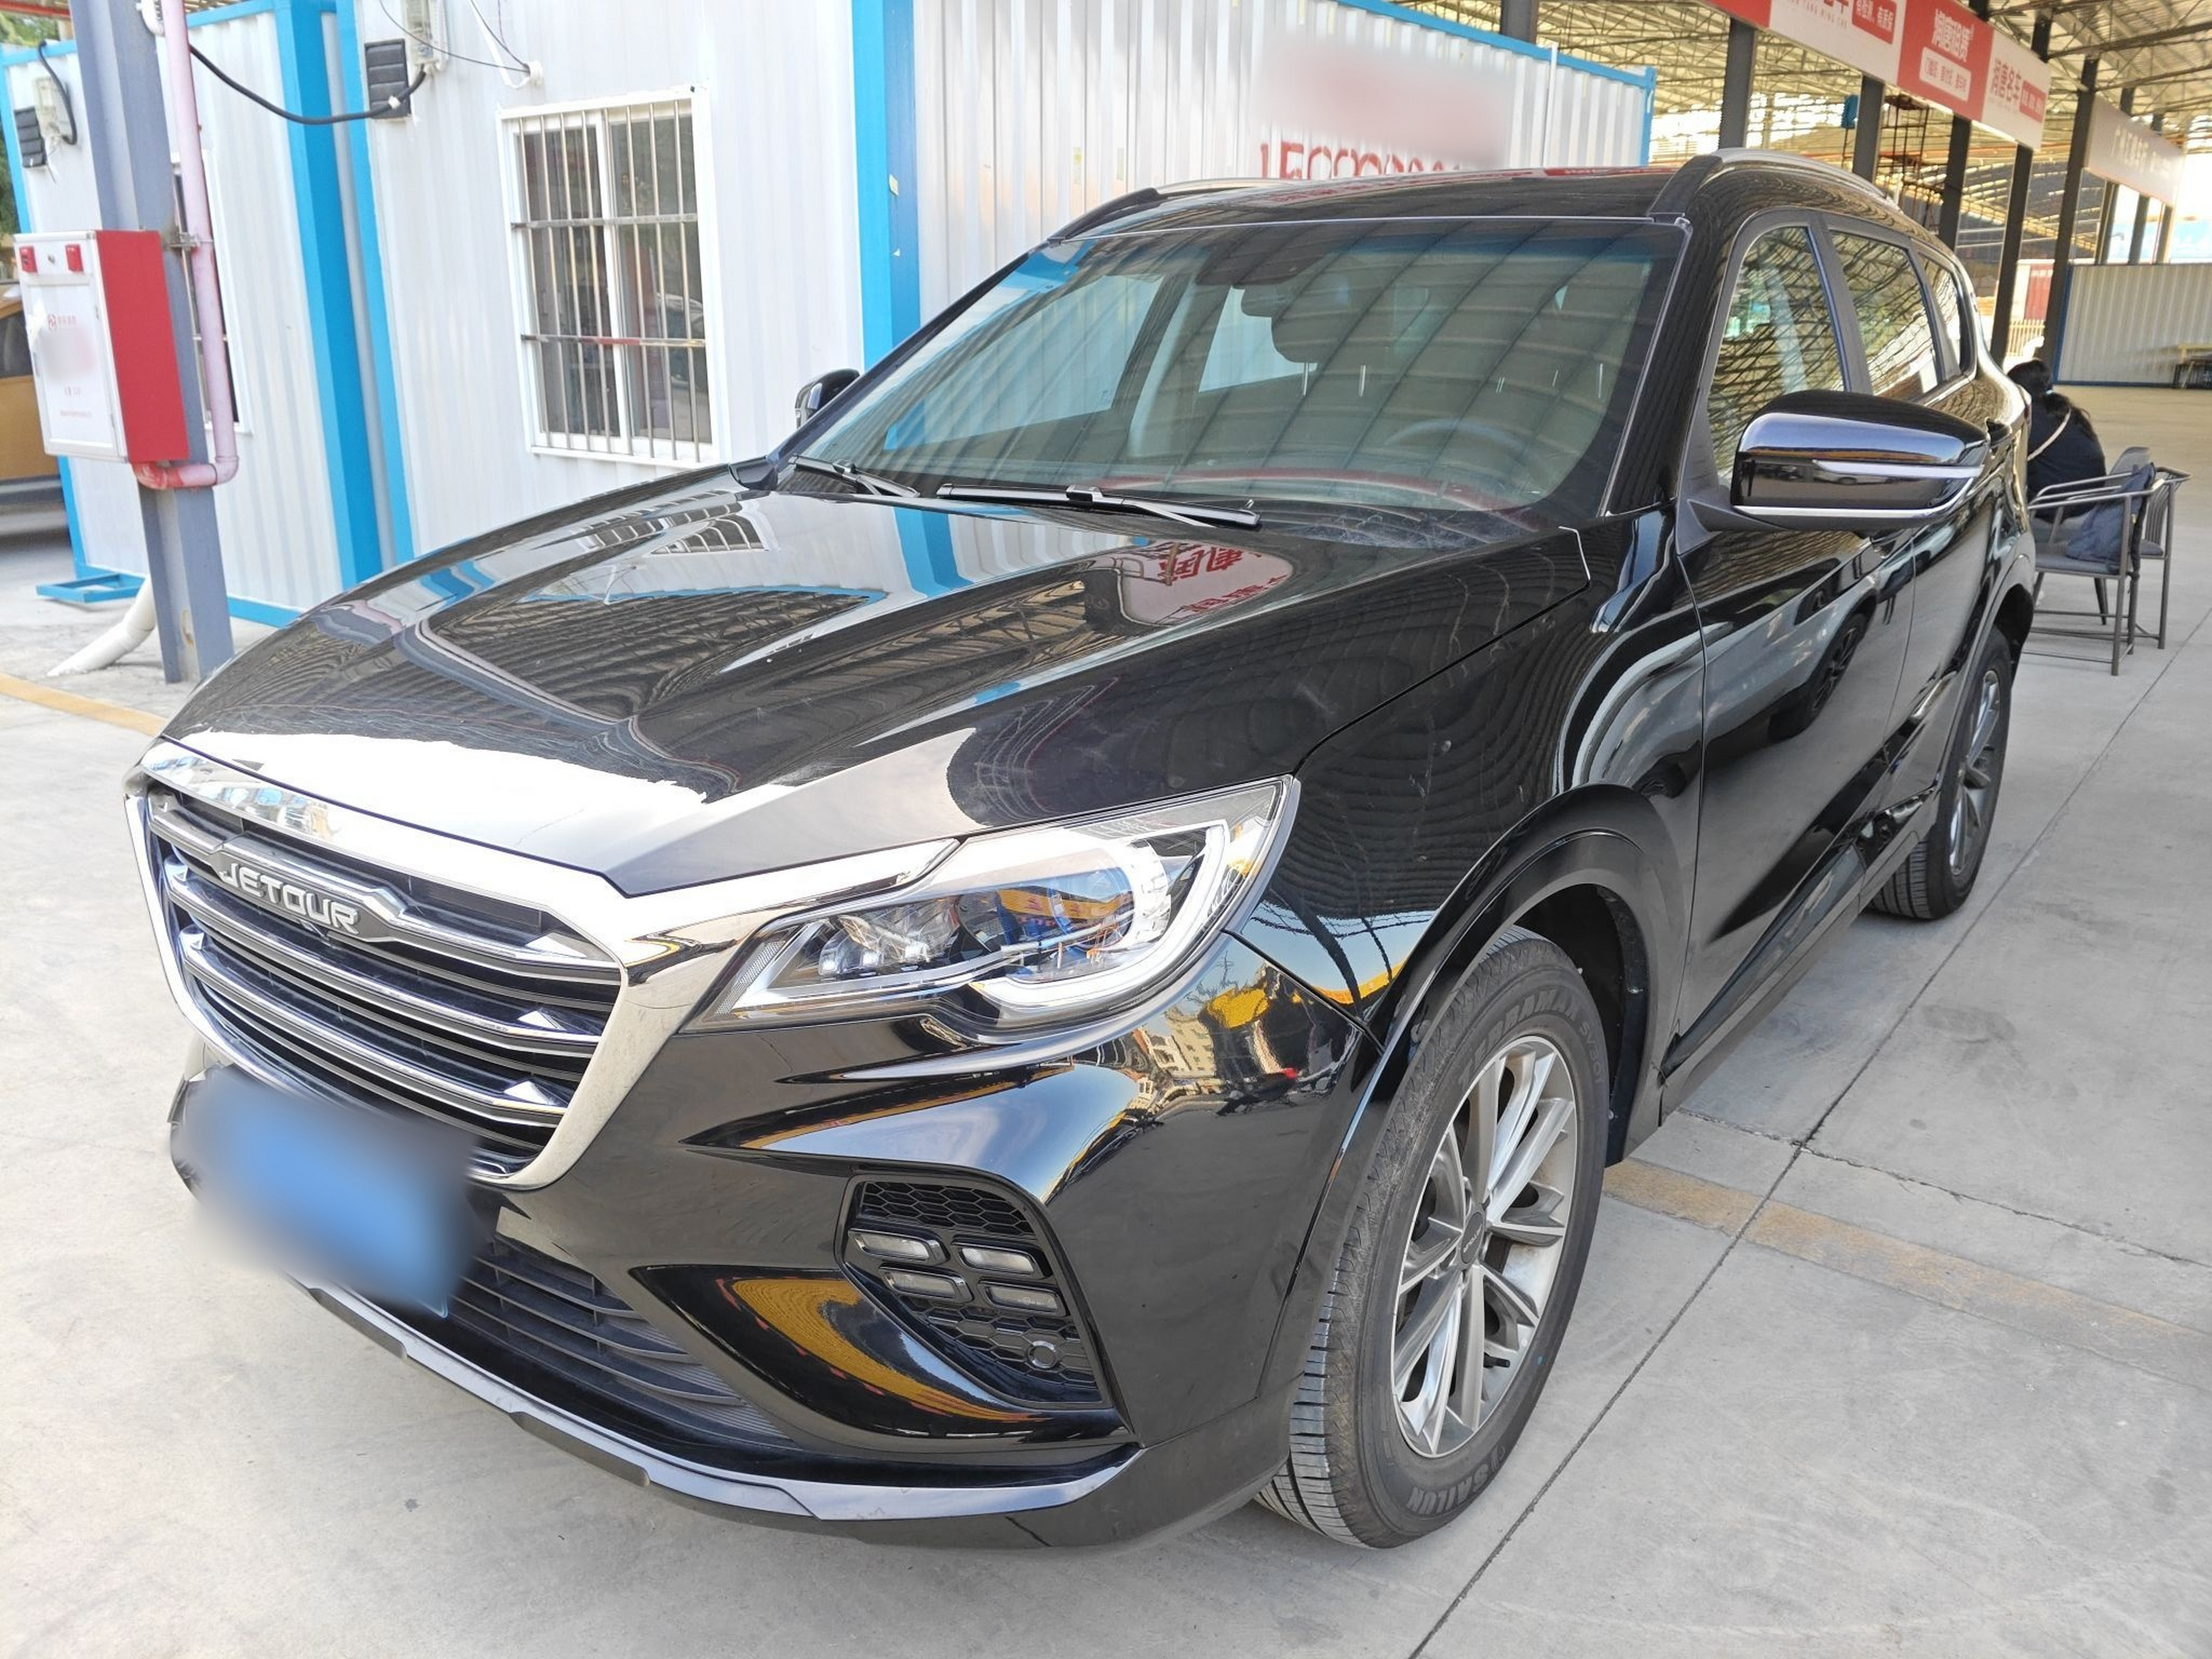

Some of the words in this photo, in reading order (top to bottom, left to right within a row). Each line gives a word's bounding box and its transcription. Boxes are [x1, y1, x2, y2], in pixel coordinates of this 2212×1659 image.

[219, 863, 361, 935] JETOUR
[1458, 987, 1579, 1088] TERRAMAX
[1406, 1463, 1490, 1514] SAILUN
